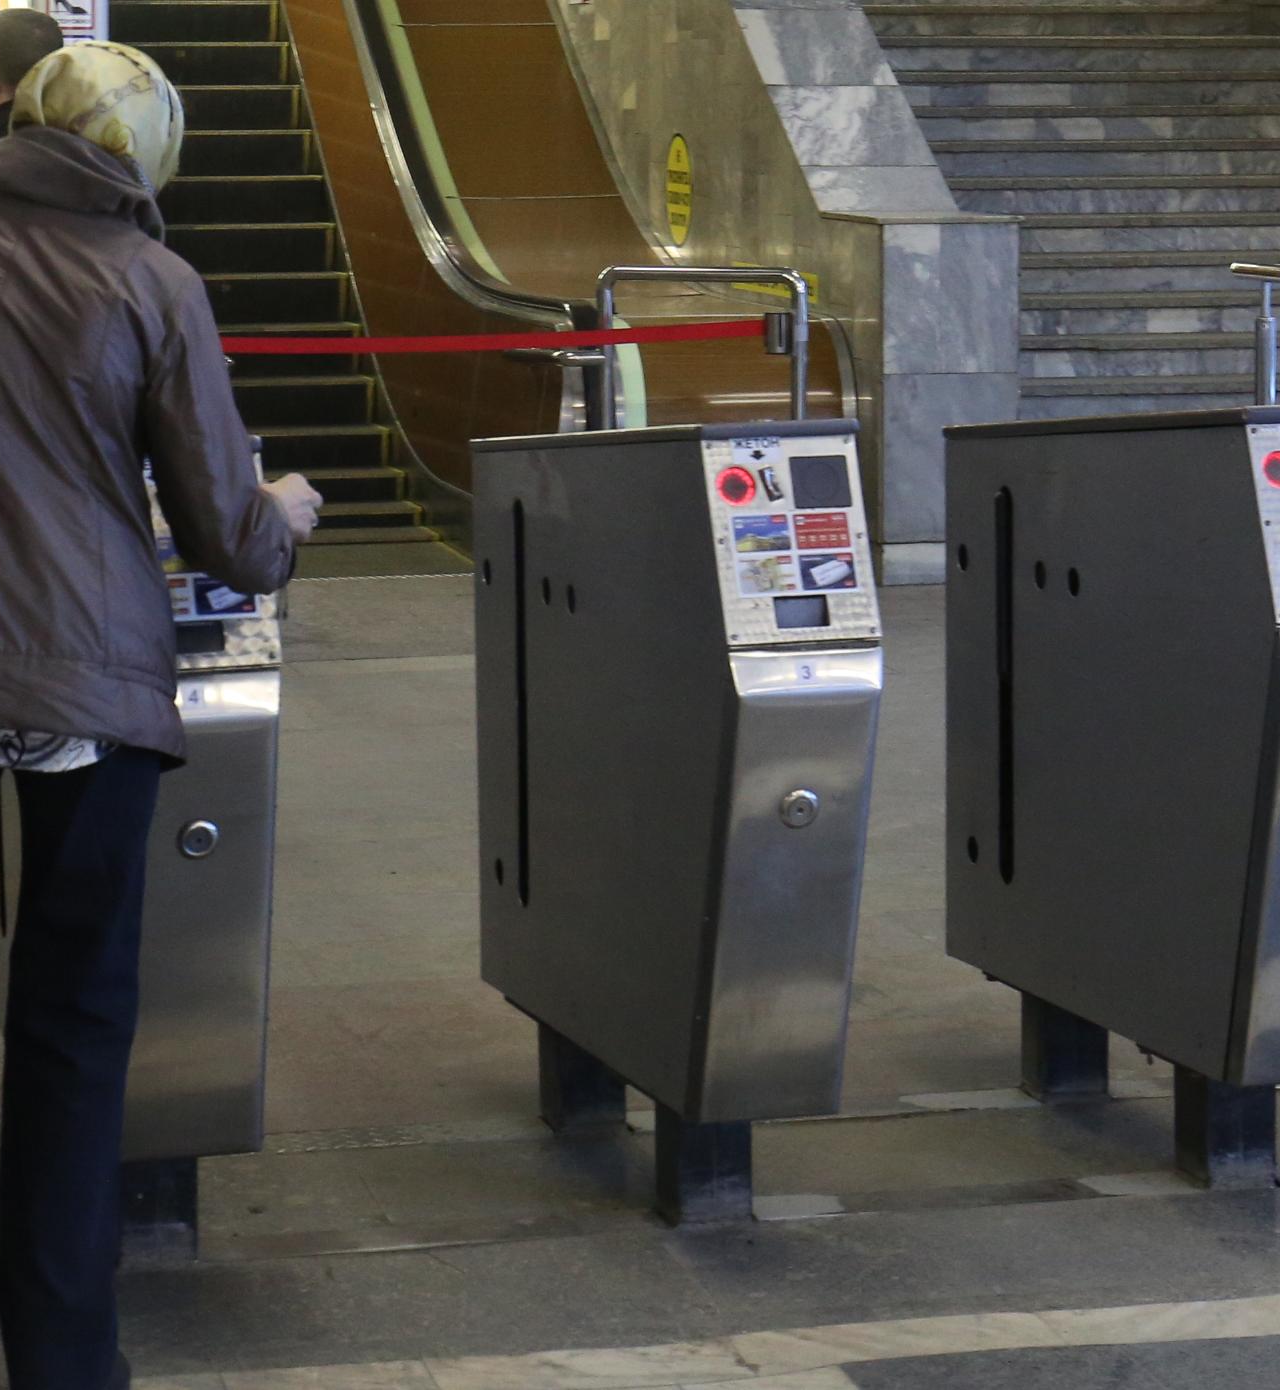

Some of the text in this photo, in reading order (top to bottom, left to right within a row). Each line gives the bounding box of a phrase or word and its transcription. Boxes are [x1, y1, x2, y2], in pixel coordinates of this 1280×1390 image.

[732, 437, 781, 449] ЖЕТОН
[801, 665, 812, 682] 3
[188, 689, 198, 704] 4
